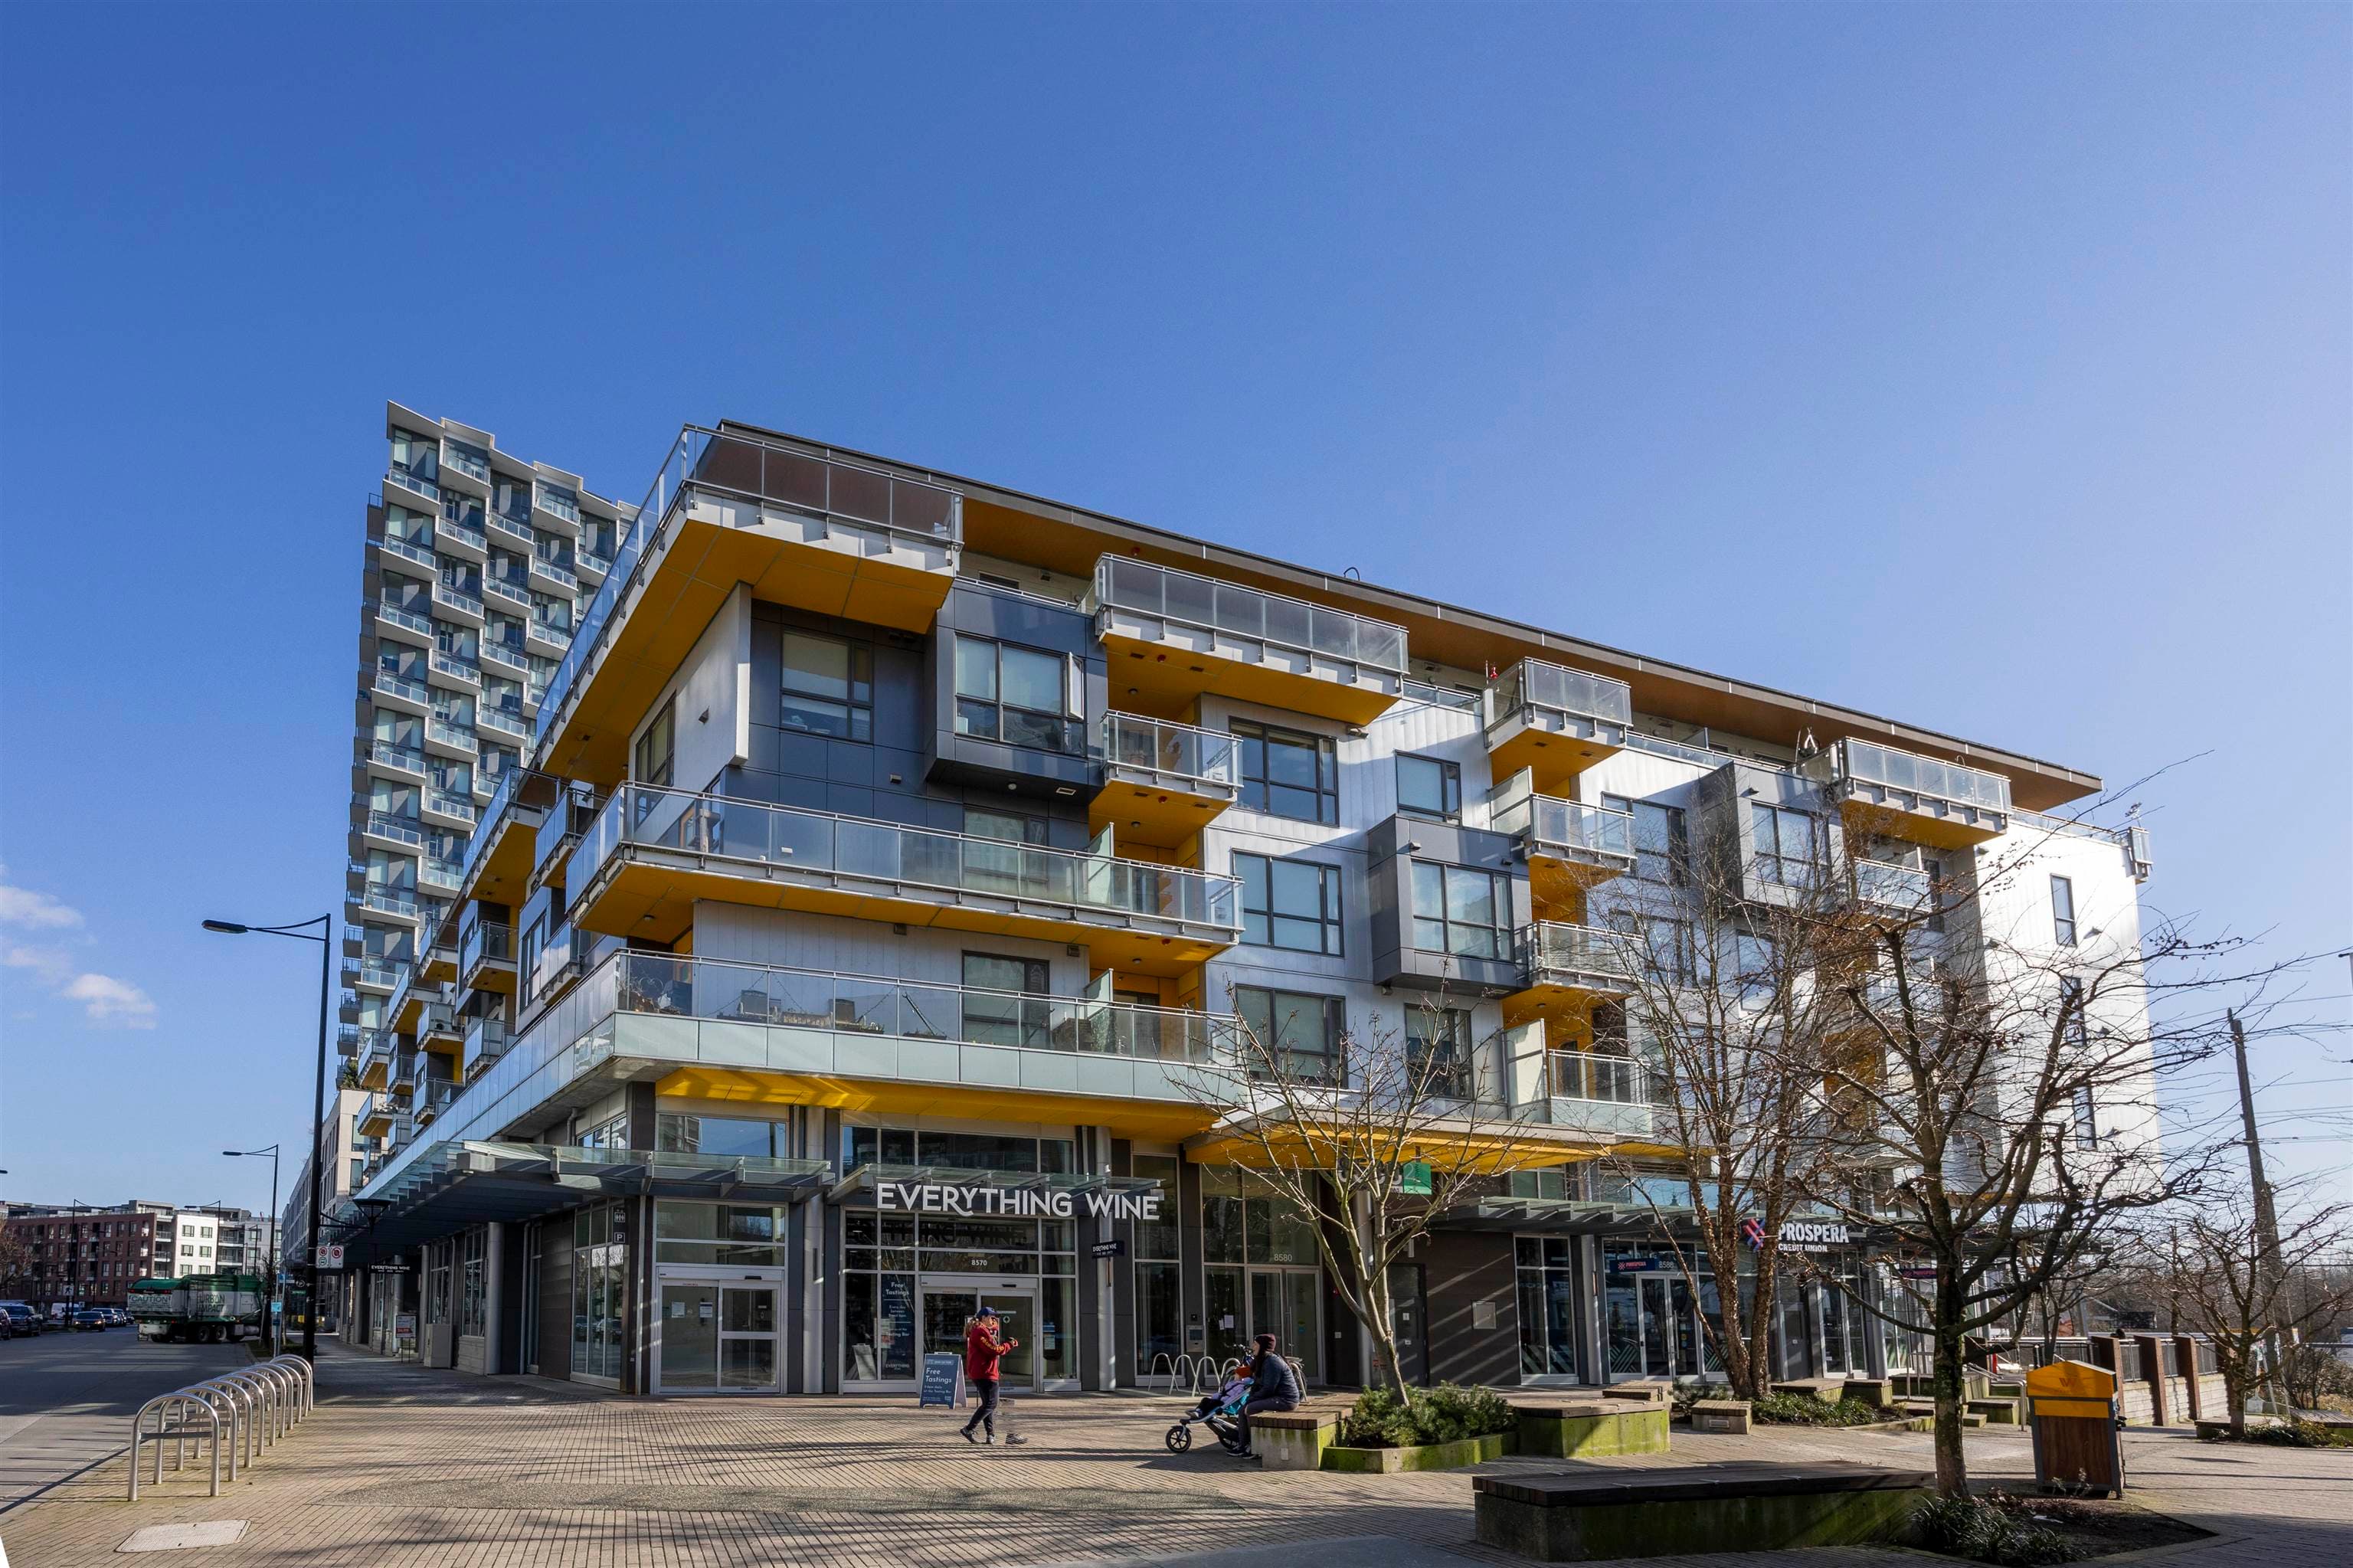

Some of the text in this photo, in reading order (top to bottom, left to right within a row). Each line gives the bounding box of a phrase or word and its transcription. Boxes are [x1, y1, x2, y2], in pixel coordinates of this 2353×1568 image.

[877, 1183, 1160, 1220] EVERYTHING WINE
[1778, 1223, 1849, 1242] PROSPERA
[1778, 1243, 1828, 1252] CREDIT UNION
[1274, 1254, 1293, 1262] 8580
[199, 1294, 225, 1303] URBAN
[925, 1376, 952, 1384] Tastings
